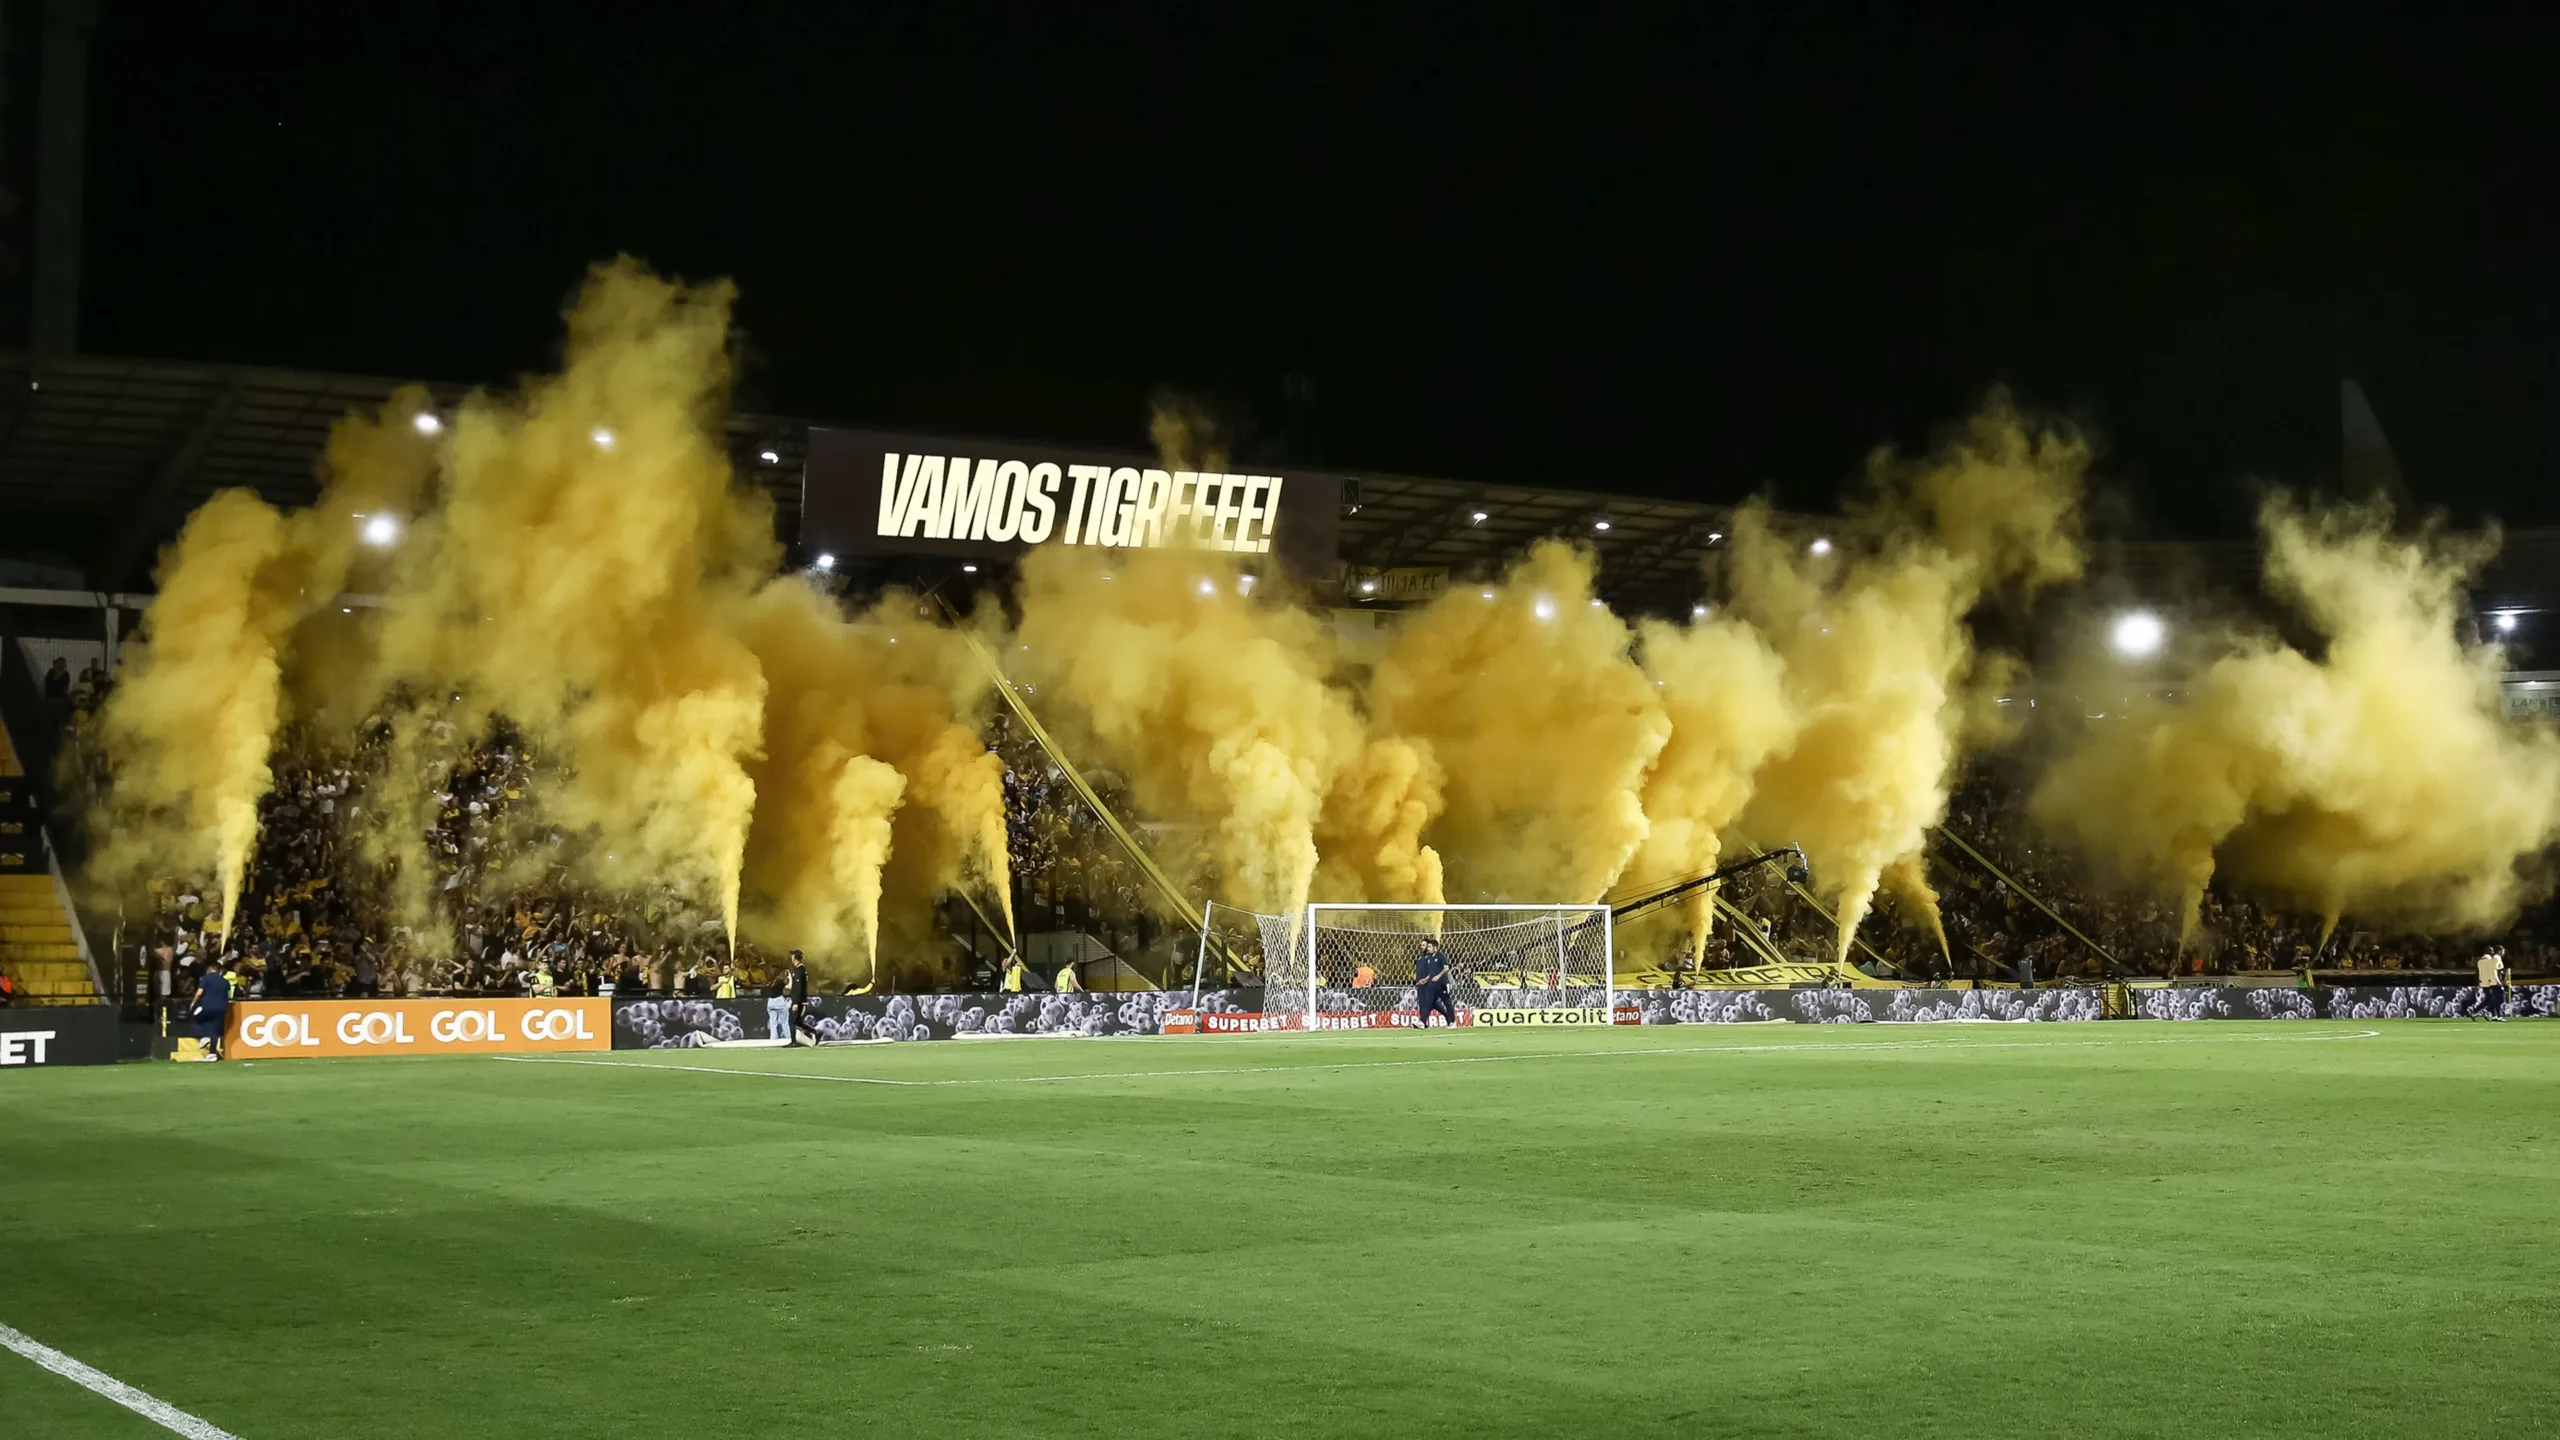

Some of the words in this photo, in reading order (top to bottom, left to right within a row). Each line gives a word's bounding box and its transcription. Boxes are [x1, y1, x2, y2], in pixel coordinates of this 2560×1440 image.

[877, 452, 1062, 544] VAMOS
[1164, 1013, 1194, 1026] Betano
[1208, 1015, 1288, 1032] SUPERBET
[1390, 1012, 1465, 1027] SUPRBT
[1479, 1009, 1607, 1027] quartzolit
[1613, 1011, 1640, 1022] tano
[240, 1013, 320, 1048] GOL
[336, 1011, 415, 1046] GOL
[430, 1010, 506, 1042] GOL
[521, 1008, 594, 1041] GOL
